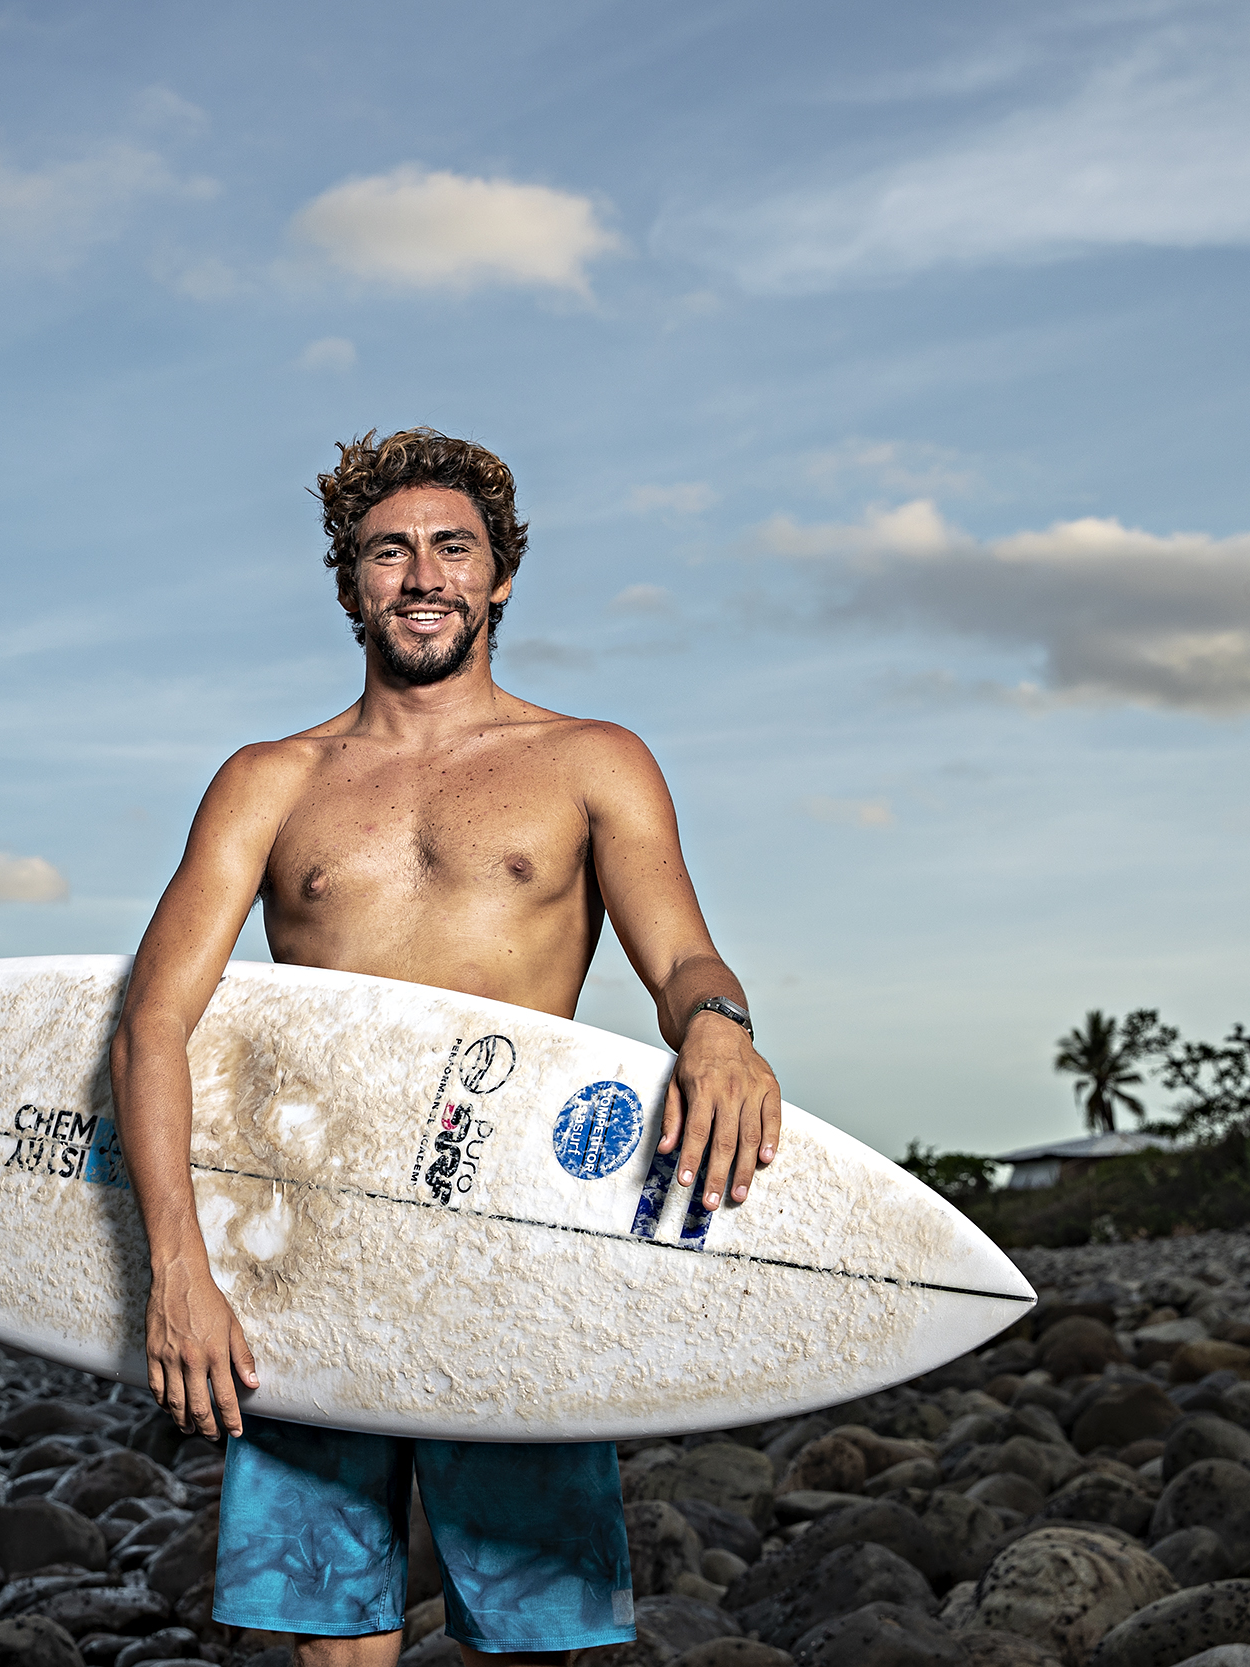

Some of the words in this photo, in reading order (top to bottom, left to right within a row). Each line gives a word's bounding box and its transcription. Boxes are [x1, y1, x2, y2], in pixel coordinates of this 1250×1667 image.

[14, 1103, 99, 1144] CHEM
[457, 1119, 494, 1194] puro
[584, 1089, 611, 1172] COMPETITOR
